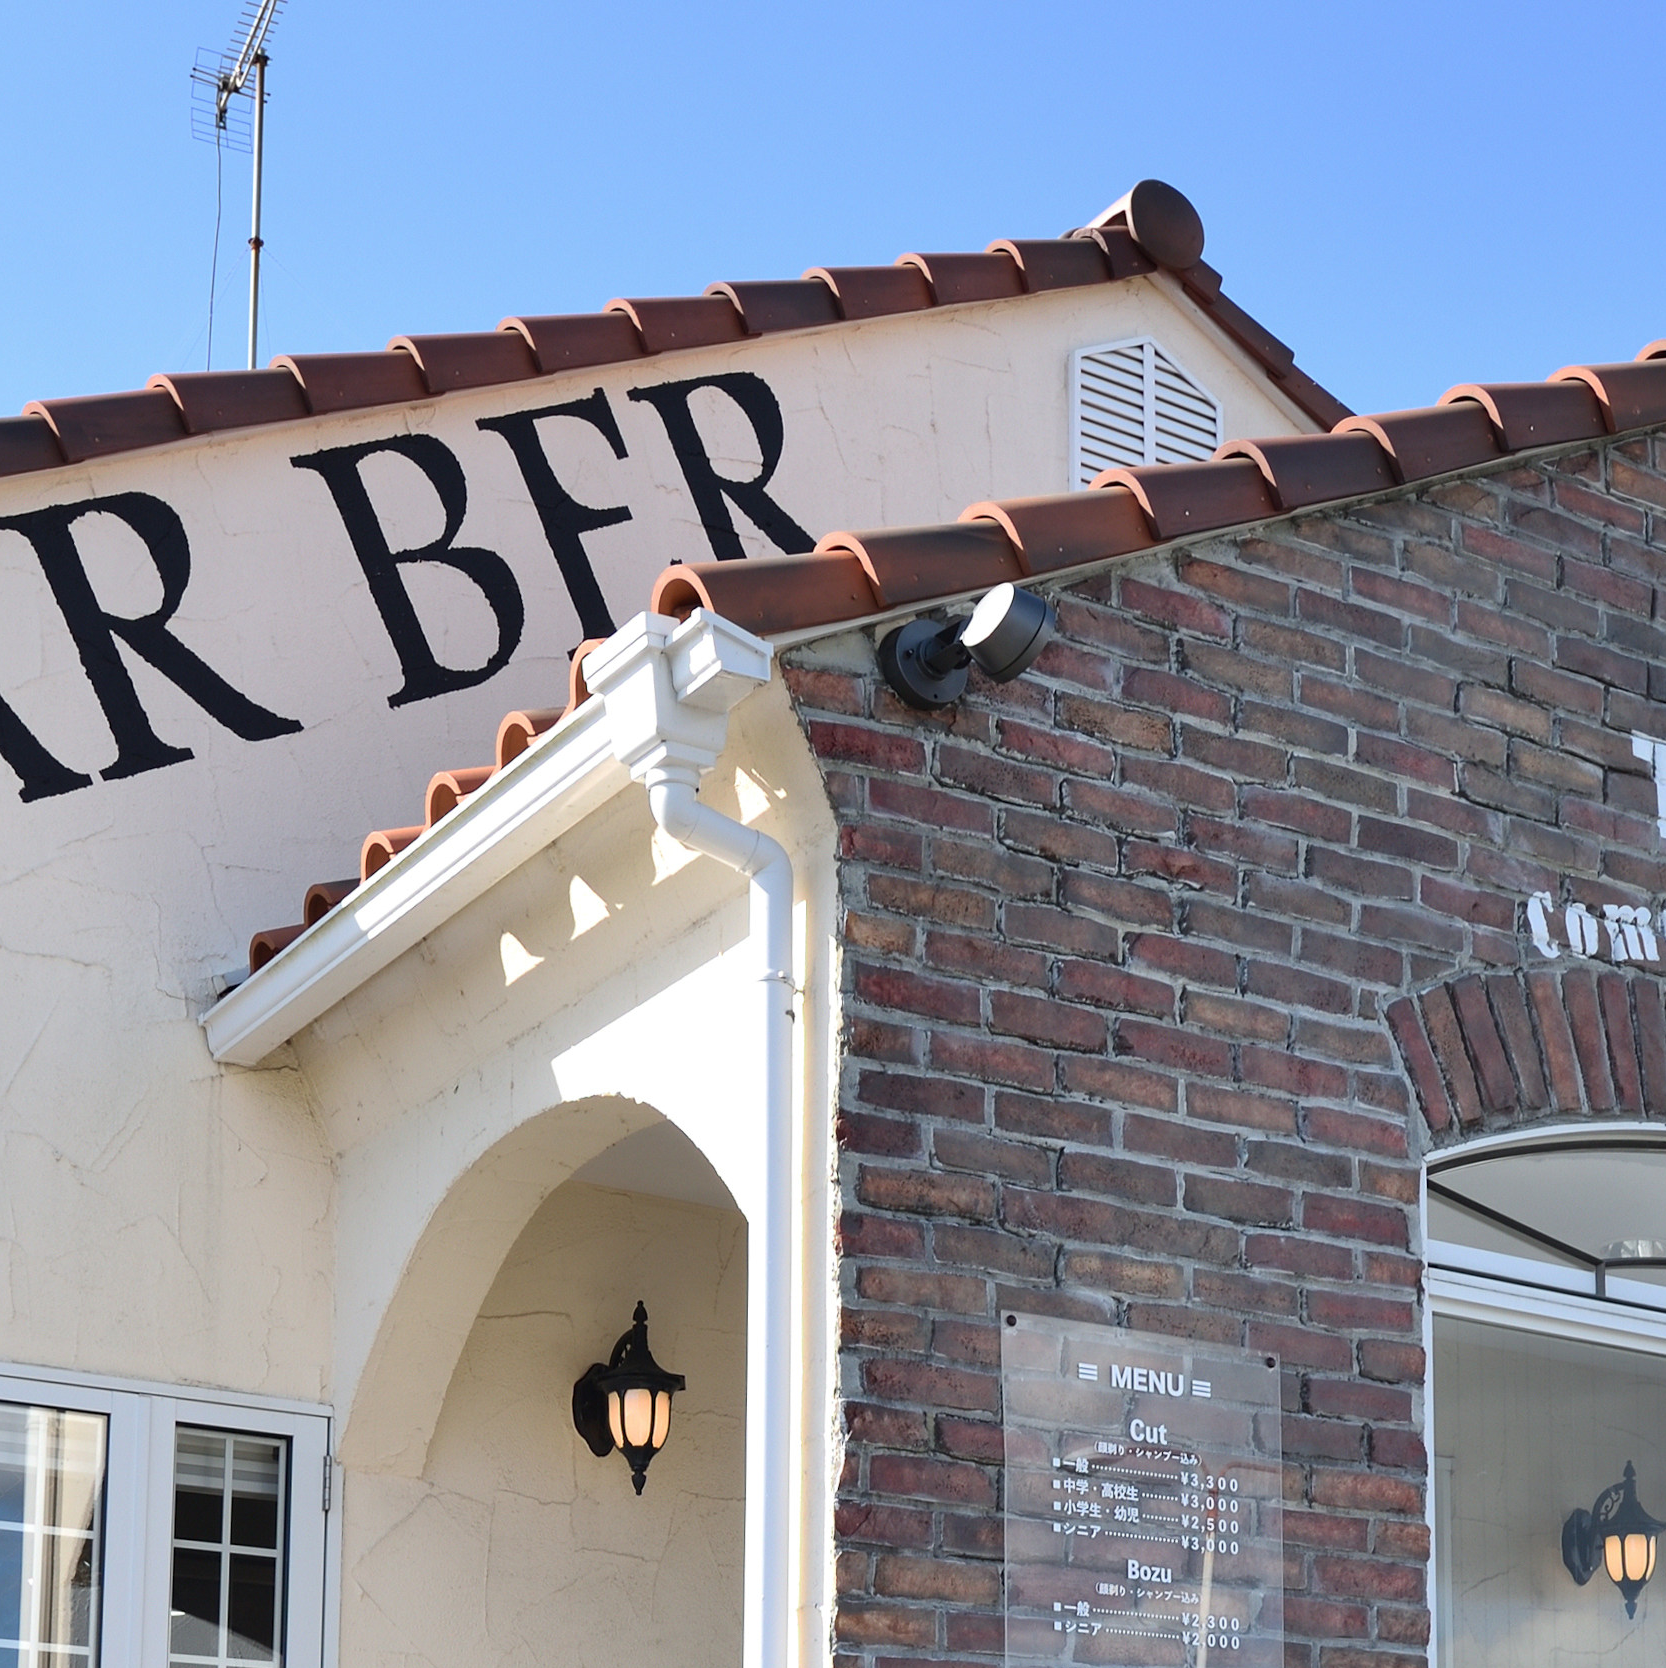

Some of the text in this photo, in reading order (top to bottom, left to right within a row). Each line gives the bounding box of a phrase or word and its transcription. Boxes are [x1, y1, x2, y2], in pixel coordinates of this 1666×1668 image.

[1110, 1363, 1184, 1398] MENU
[1129, 1418, 1168, 1446] Cut
[1063, 1522, 1101, 1539] シニア
[1127, 1558, 1173, 1584] Bozu
[1065, 1621, 1102, 1636] シニア
